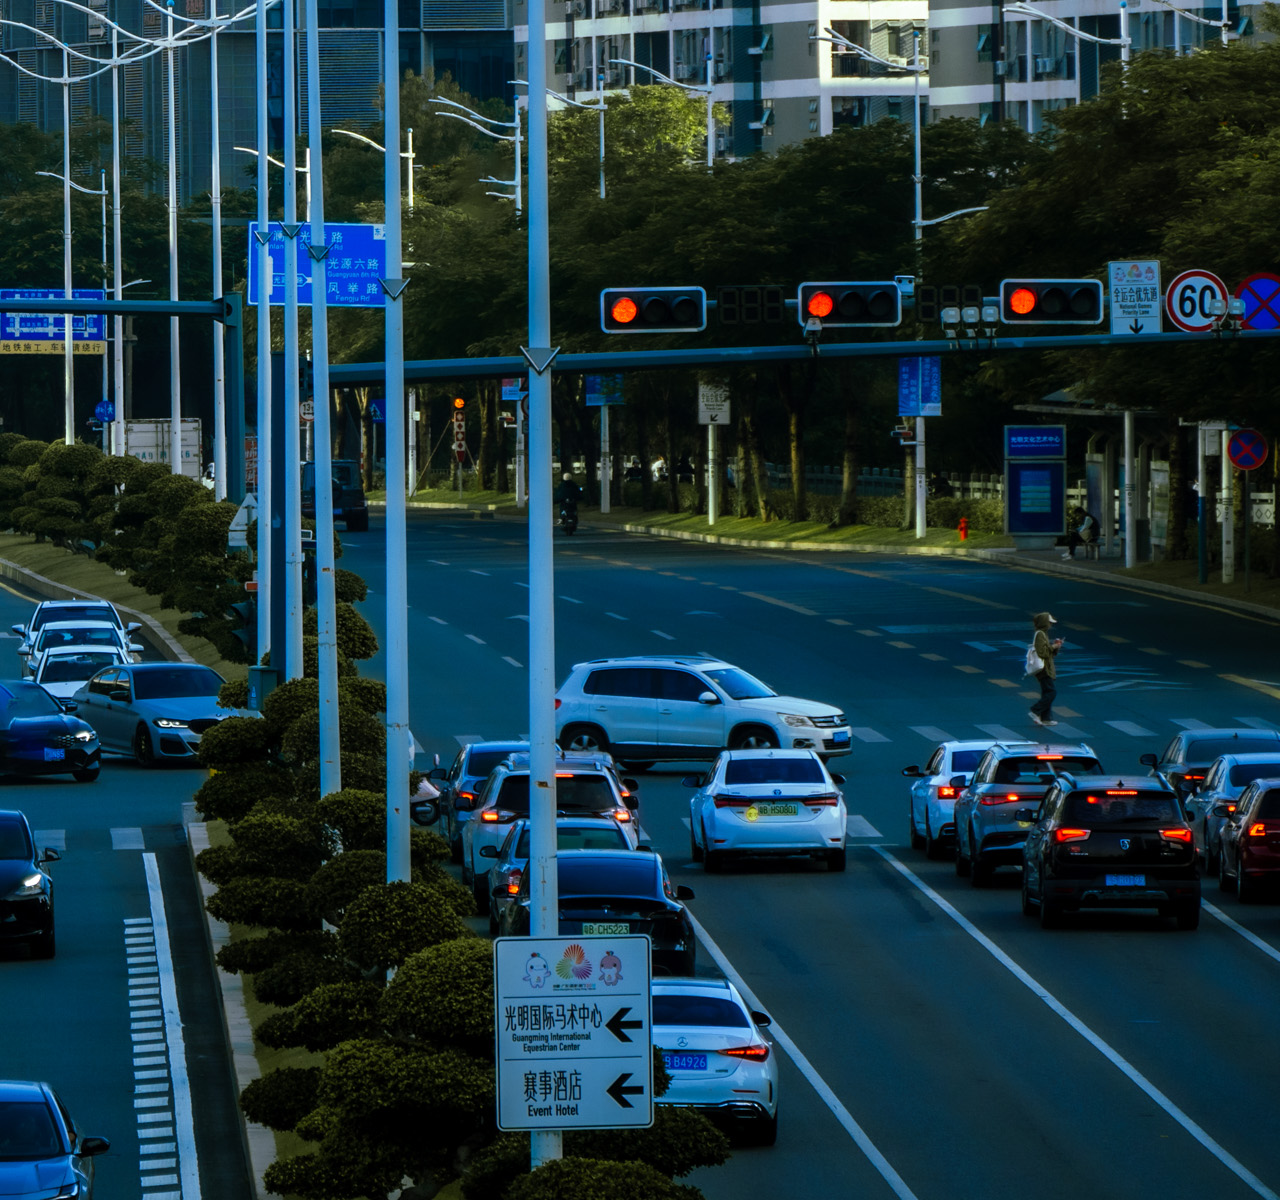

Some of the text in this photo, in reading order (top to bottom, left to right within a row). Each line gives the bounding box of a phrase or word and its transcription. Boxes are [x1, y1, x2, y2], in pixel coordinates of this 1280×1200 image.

[328, 258, 379, 270] 光源六路
[328, 271, 360, 279] Guangyuan
[328, 282, 379, 295] 凤举路
[1113, 286, 1158, 303] 全运会优先道
[1179, 284, 1217, 319] 60
[505, 1003, 603, 1032] 光明国际马术中心
[512, 1032, 592, 1044] Guangming International
[523, 1043, 581, 1053] Equestrian Center
[523, 1069, 582, 1102] 赛事酒店
[528, 1104, 579, 1117] Event Hotel
